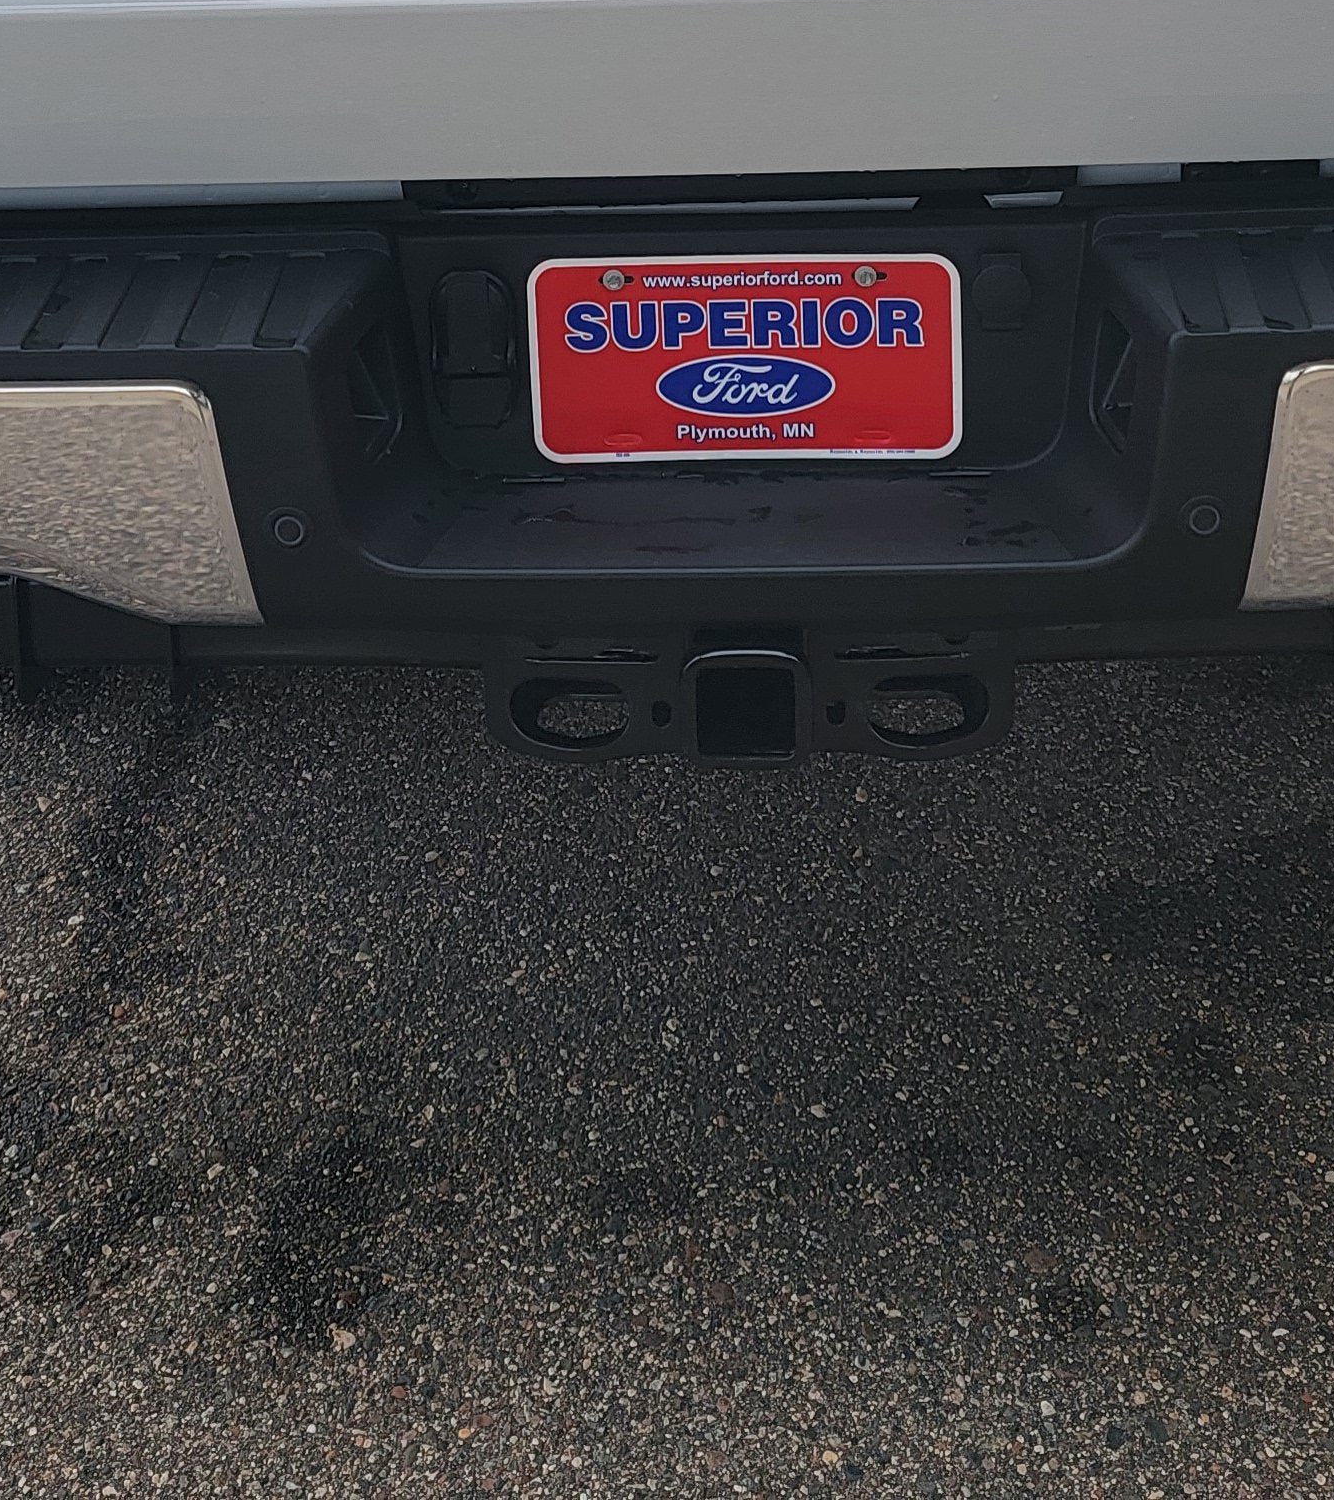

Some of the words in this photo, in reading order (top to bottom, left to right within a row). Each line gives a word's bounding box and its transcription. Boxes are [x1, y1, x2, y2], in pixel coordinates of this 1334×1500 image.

[642, 270, 842, 290] www.superiorford.com
[564, 296, 925, 353] SUPERIOR
[692, 363, 800, 406] Ford
[676, 423, 777, 443] Plymouth,
[782, 422, 815, 439] MN
